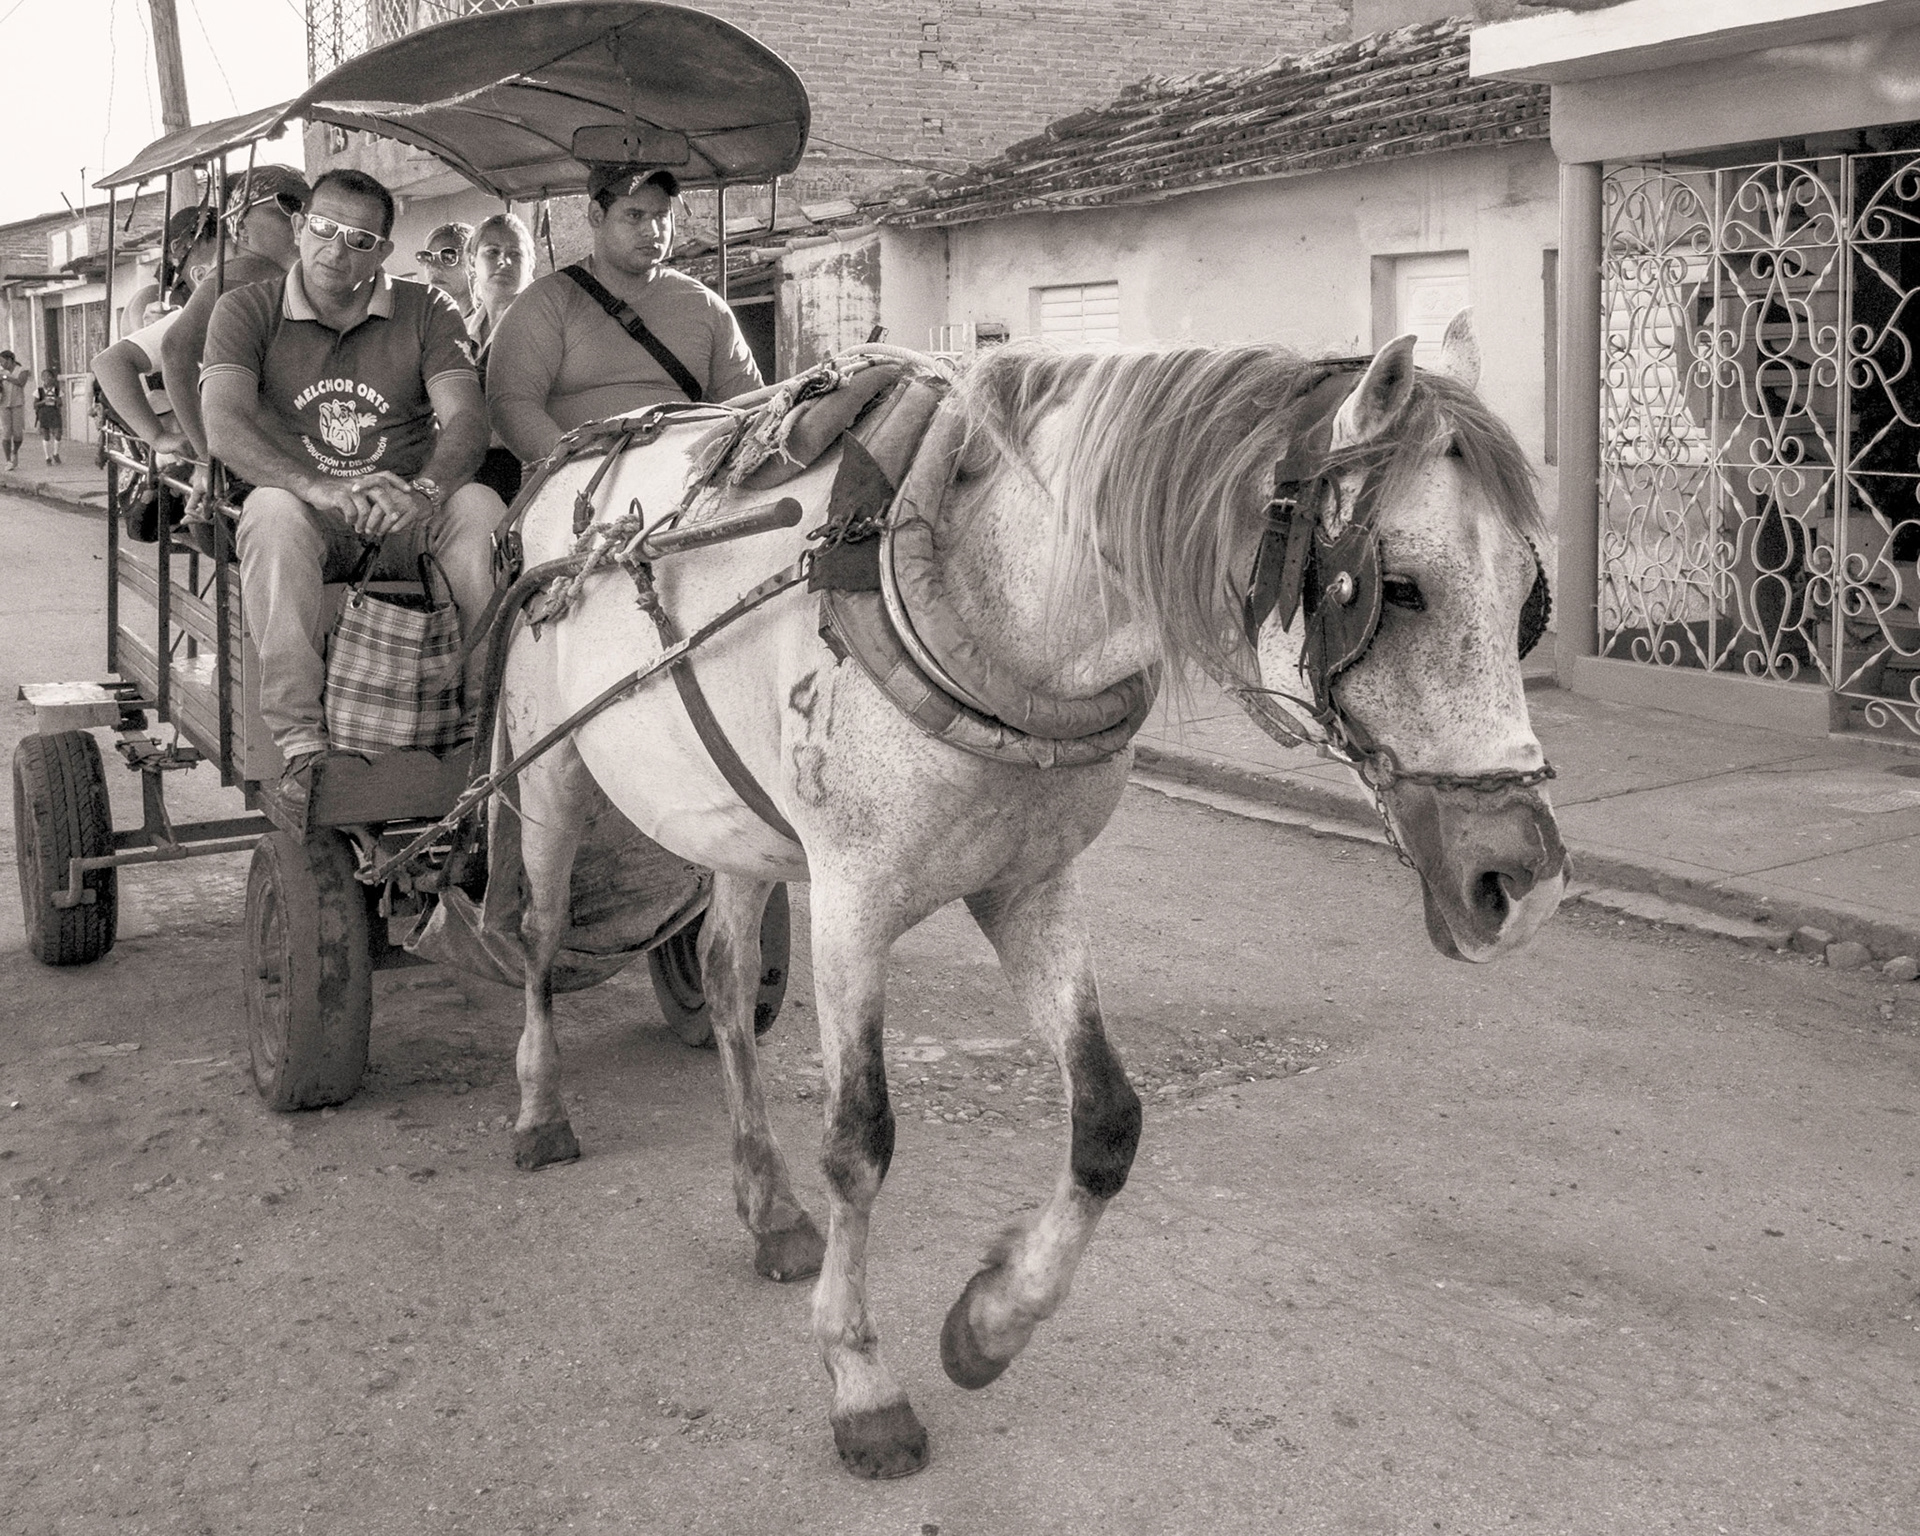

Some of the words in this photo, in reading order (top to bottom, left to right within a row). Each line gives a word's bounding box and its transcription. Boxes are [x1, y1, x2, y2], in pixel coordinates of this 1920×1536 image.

[293, 378, 354, 411] MELCHOR
[357, 383, 390, 414] ORTS
[317, 463, 330, 473] DE
[330, 464, 376, 477] HORTALIZAS
